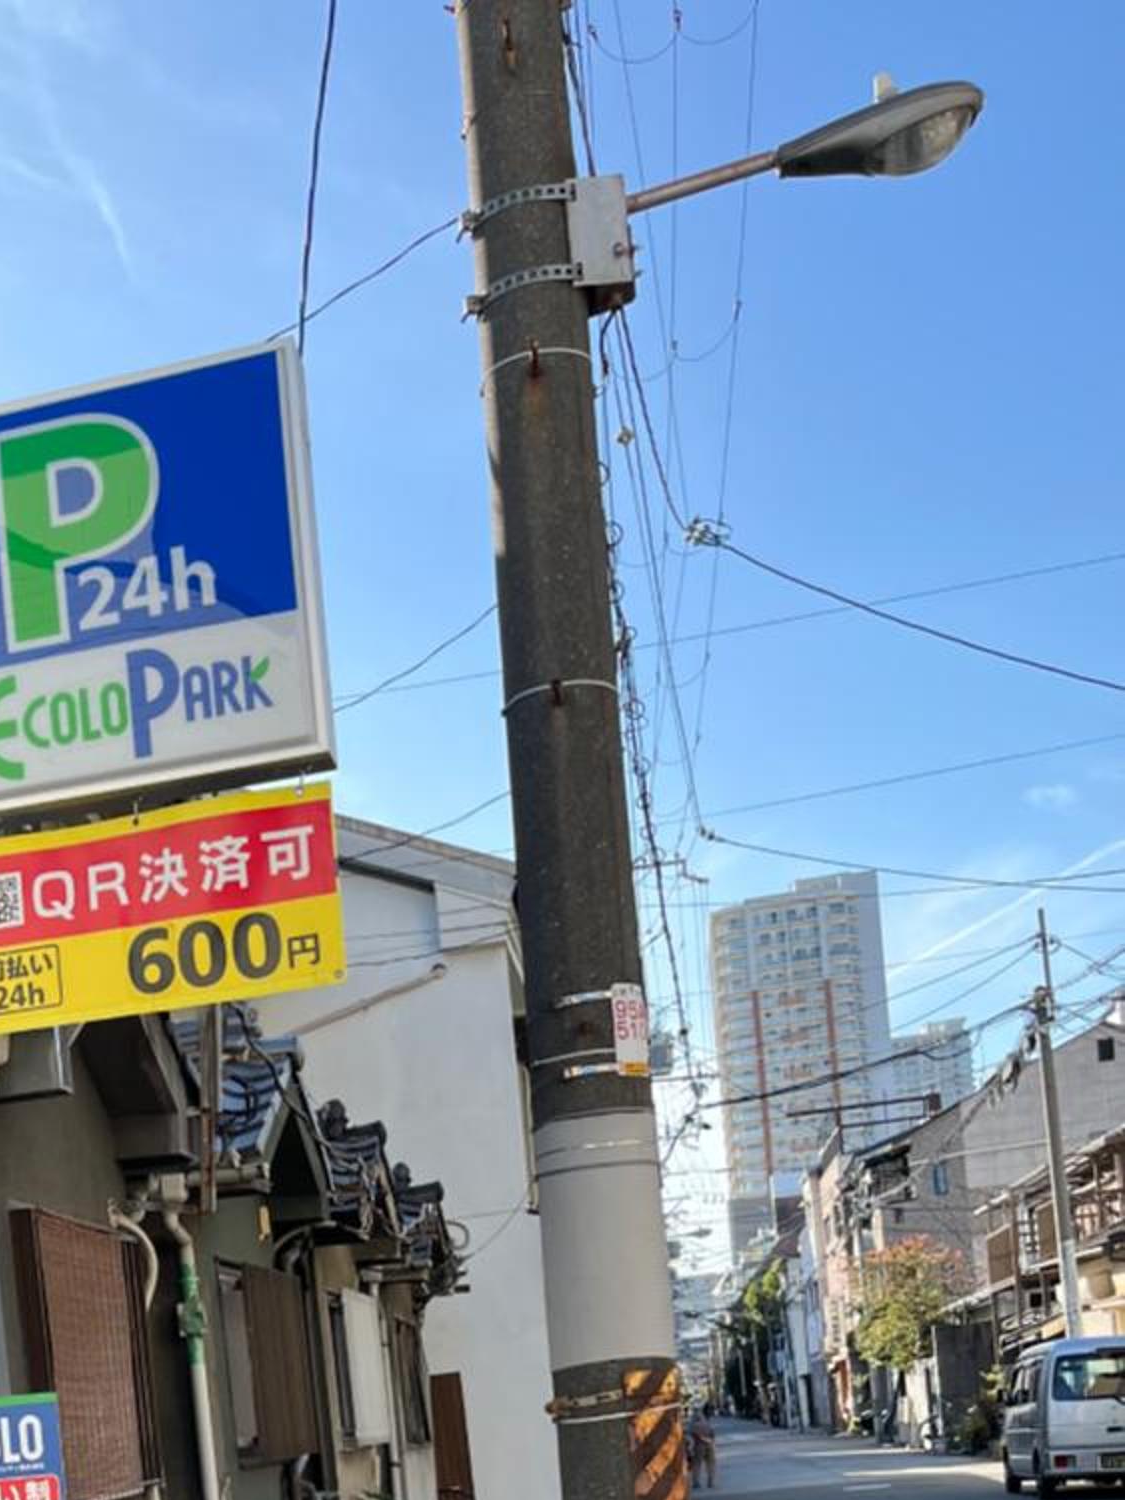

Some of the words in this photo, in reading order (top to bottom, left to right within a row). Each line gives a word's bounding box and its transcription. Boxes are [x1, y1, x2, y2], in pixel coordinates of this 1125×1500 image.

[77, 545, 217, 632] 24h
[32, 825, 315, 920] QR決済可
[128, 912, 321, 995] 600円
